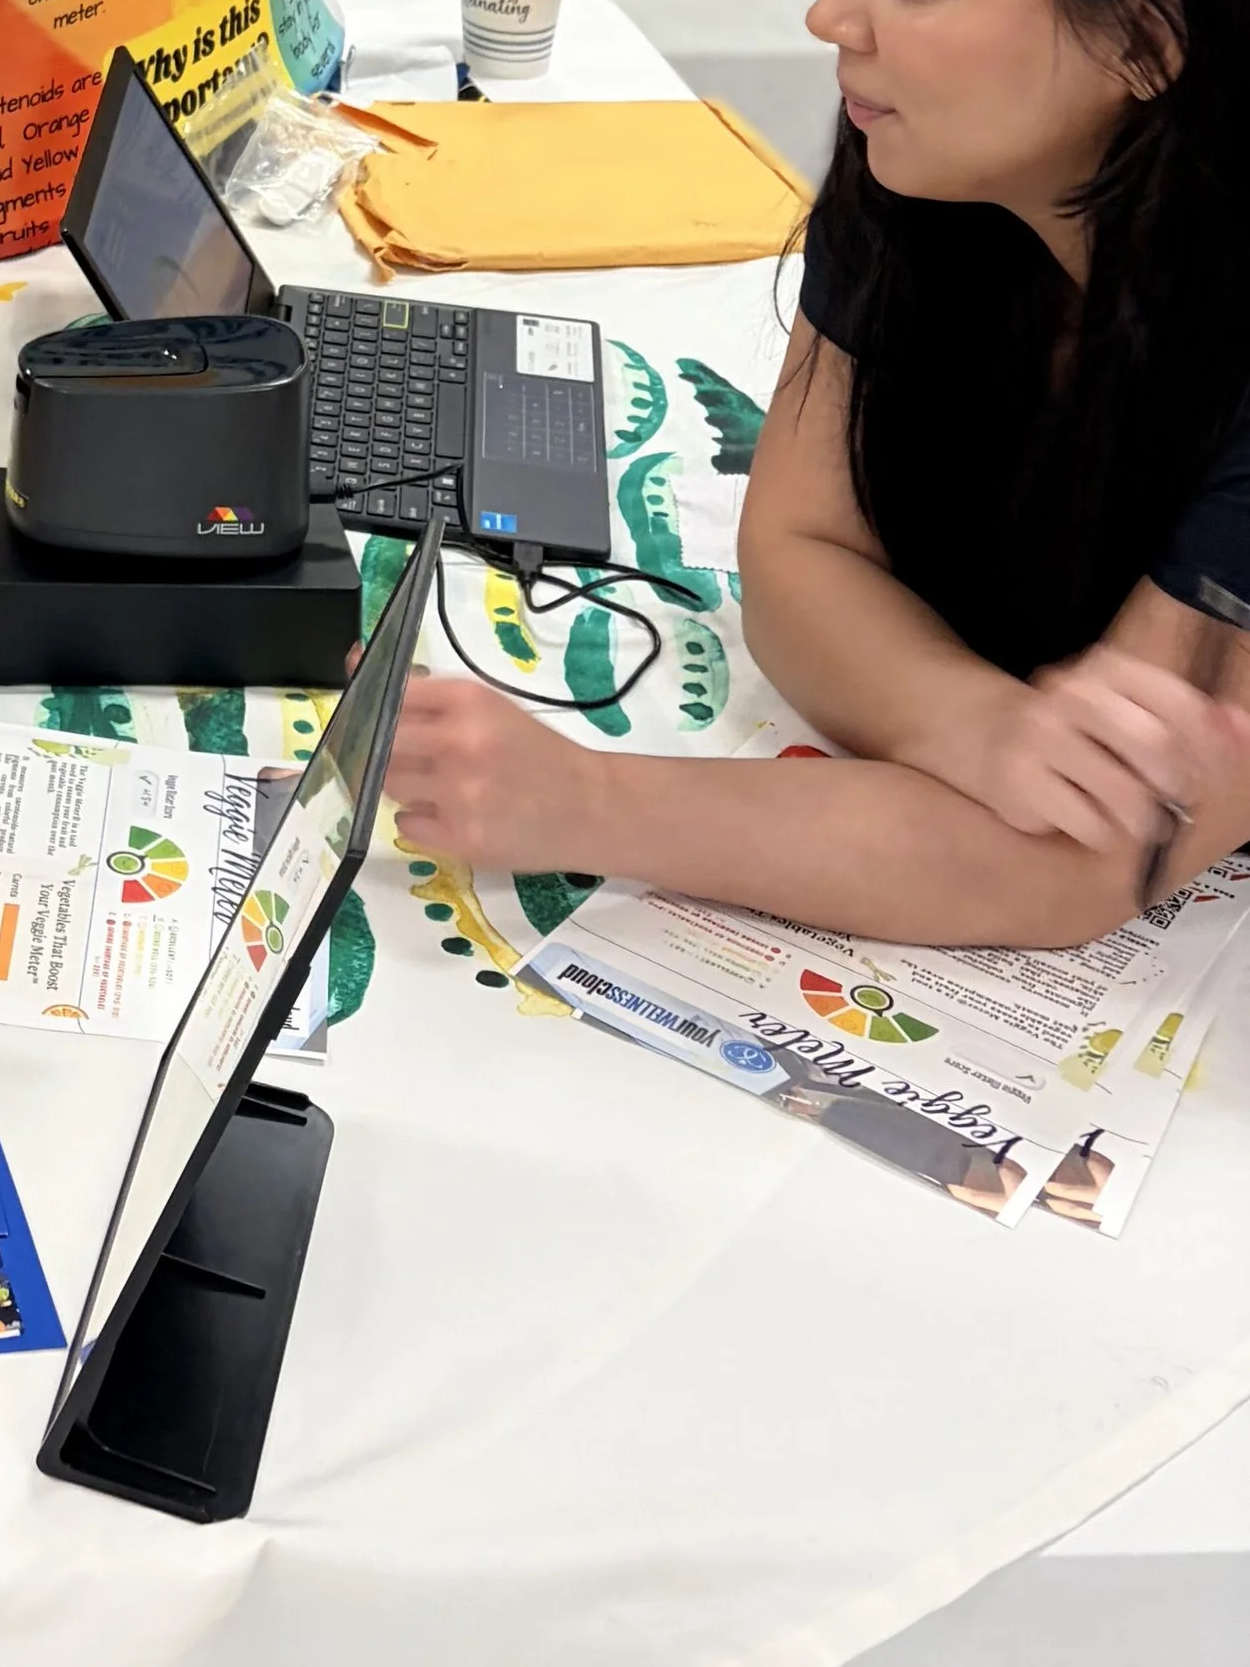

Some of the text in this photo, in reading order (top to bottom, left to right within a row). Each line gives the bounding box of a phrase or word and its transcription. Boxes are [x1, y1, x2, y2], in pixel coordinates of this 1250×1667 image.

[53, 1, 106, 29] meter.
[192, 26, 215, 64] is
[71, 71, 102, 93] are
[22, 108, 90, 138] Orange
[21, 145, 79, 174] Yellow
[197, 523, 264, 535] VIEW
[203, 773, 272, 843] Veggie
[9, 873, 23, 898] Carrots
[37, 883, 54, 907] Your
[30, 910, 50, 943] Veggie
[46, 879, 76, 991] Vegetables That Boost
[770, 916, 855, 958] Vegetables
[557, 963, 721, 1048] yourWELLNESScloud
[738, 1011, 875, 1088] Meter
[881, 1081, 1024, 1165] Veggie
